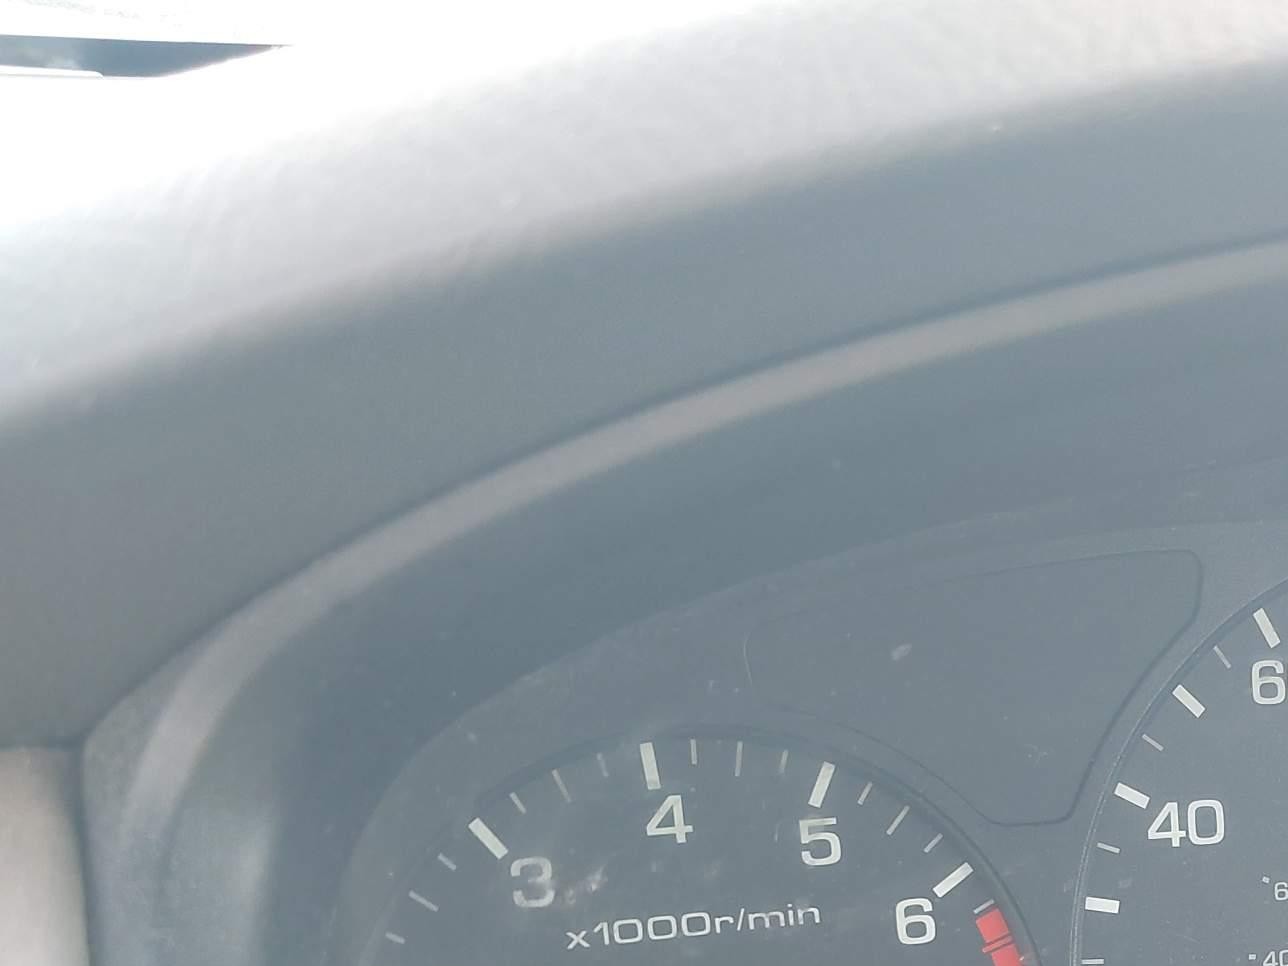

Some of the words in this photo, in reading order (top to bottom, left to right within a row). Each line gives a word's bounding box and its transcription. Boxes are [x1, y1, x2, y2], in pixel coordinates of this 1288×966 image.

[645, 795, 693, 844] 4
[799, 816, 842, 866] 5
[1146, 800, 1226, 848] 40
[510, 857, 555, 908] 3
[895, 898, 937, 945] 6
